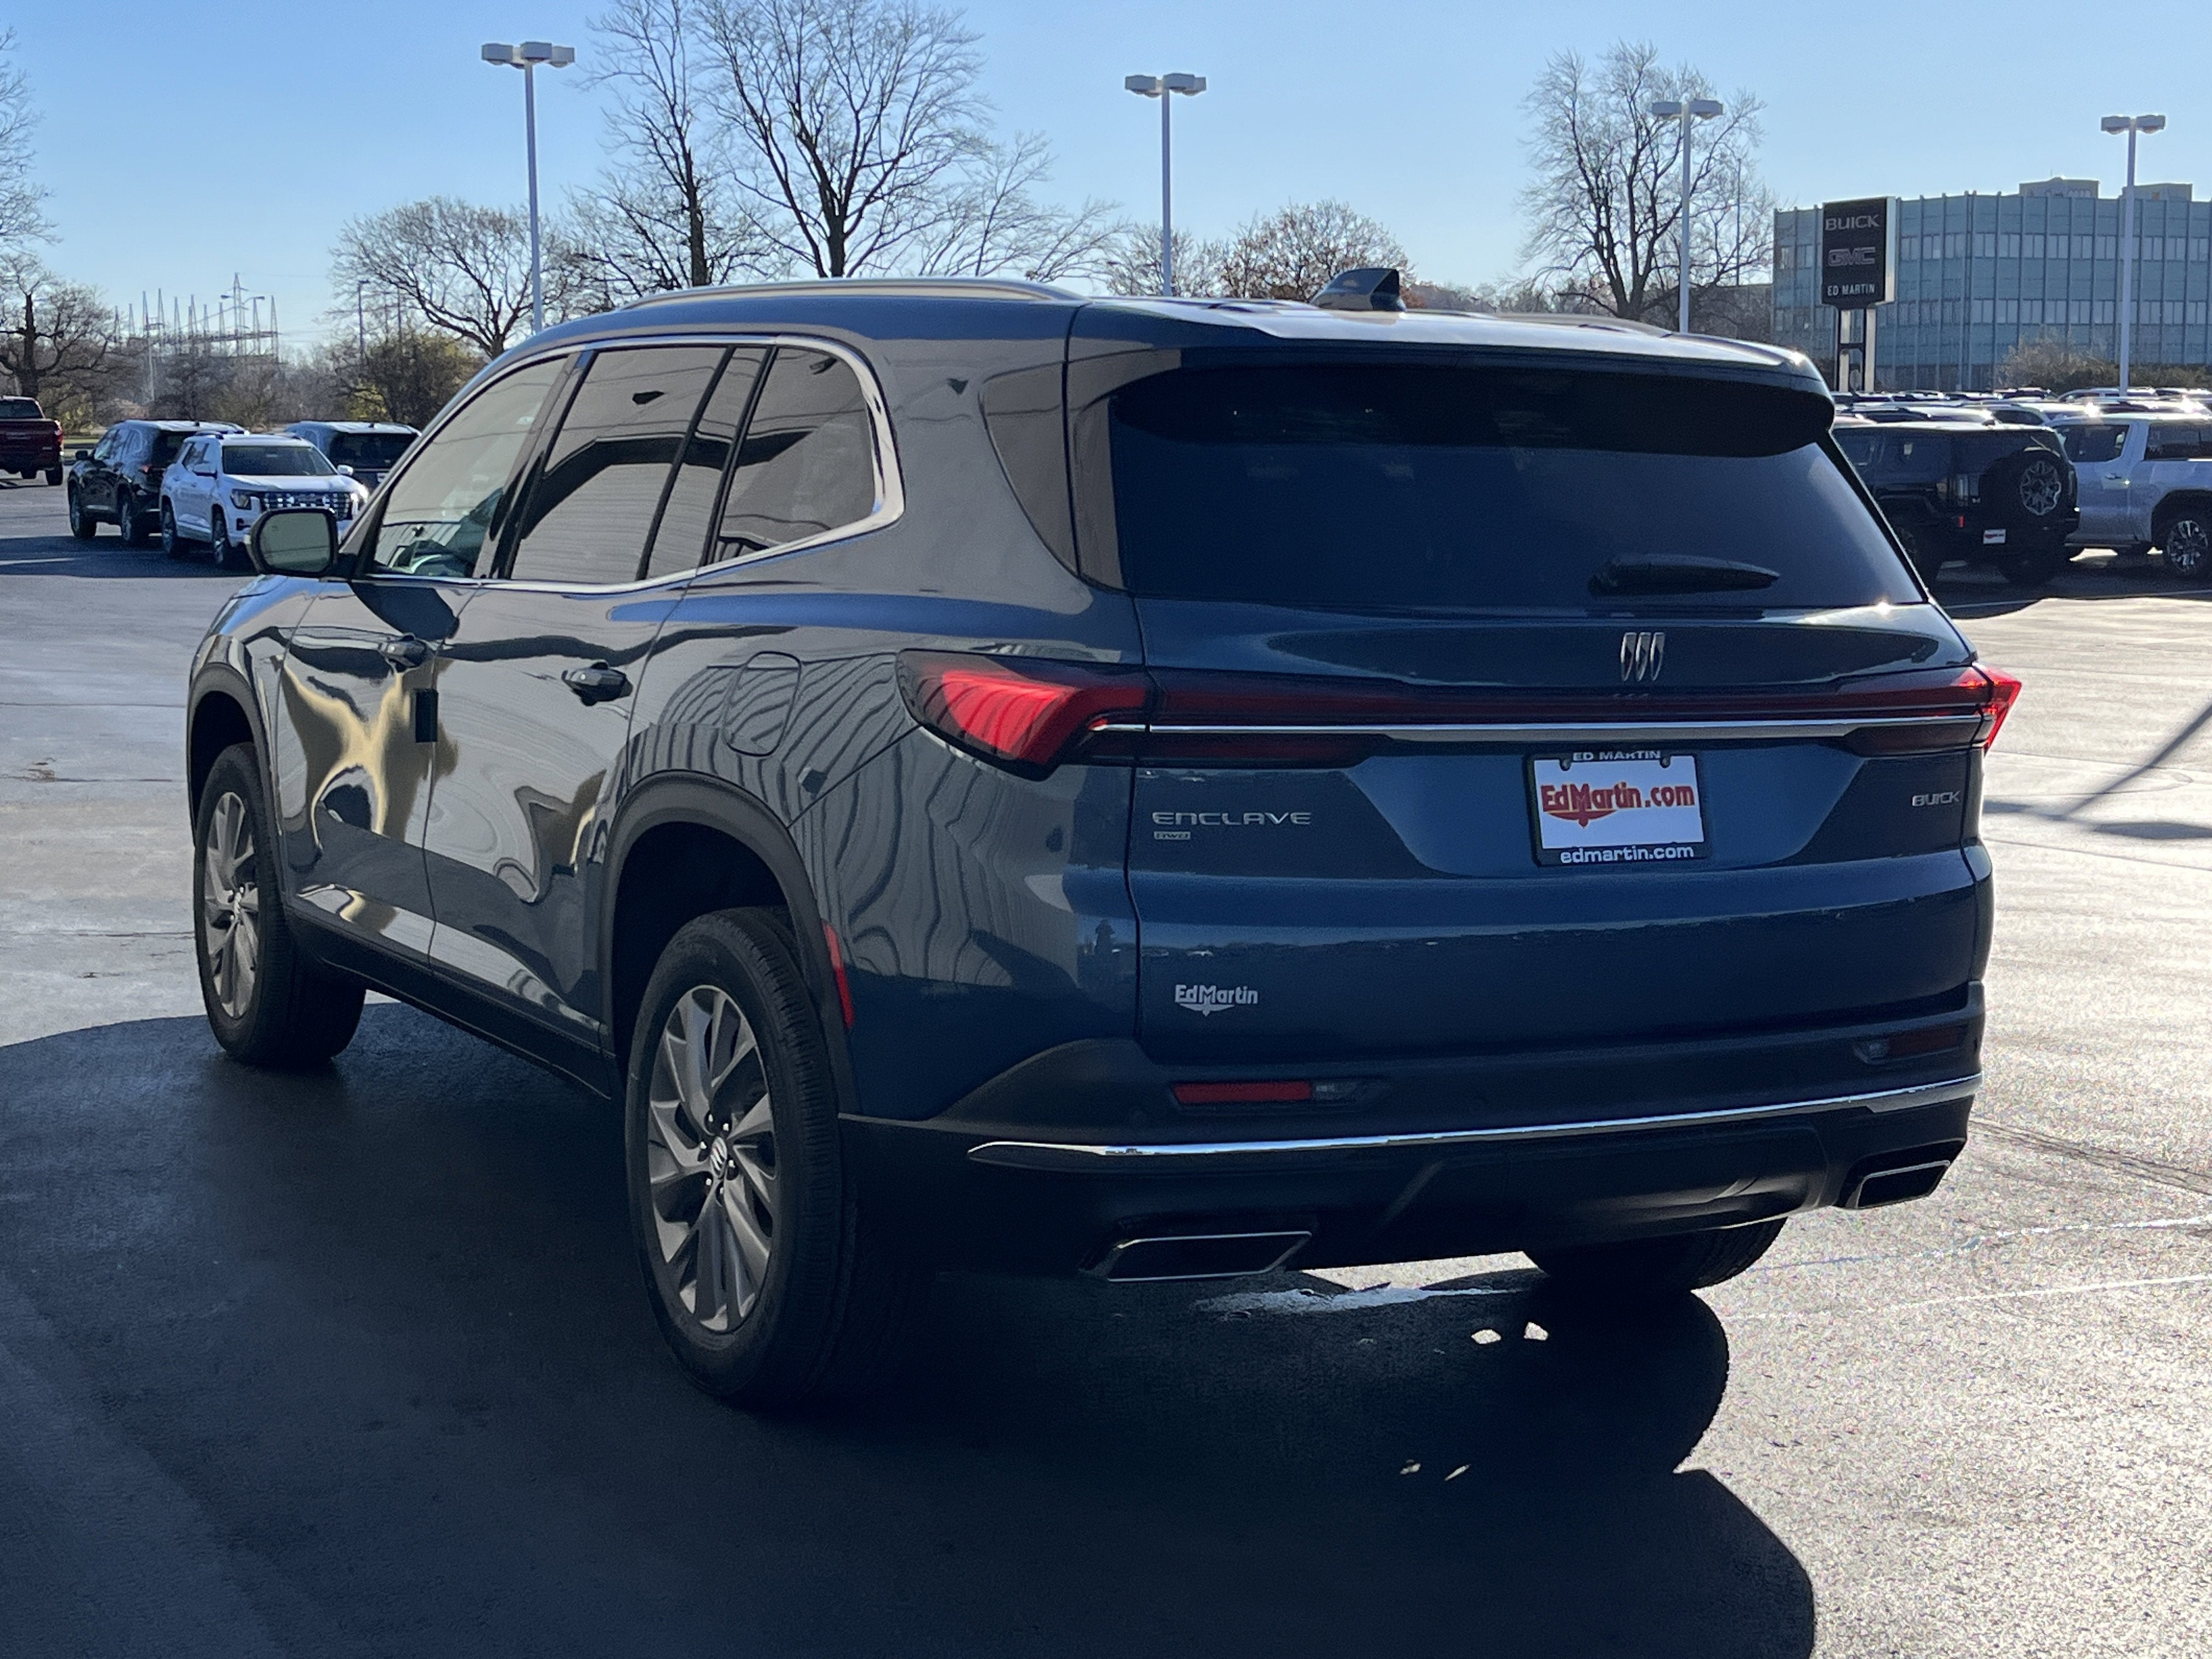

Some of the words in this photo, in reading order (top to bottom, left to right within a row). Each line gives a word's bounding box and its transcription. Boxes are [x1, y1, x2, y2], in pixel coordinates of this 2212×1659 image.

[1825, 214, 1879, 230] BUICK
[1828, 247, 1876, 267] GMC
[1827, 285, 1839, 296] ED
[1842, 284, 1875, 295] MARTIN
[1573, 752, 1594, 761] ED
[1599, 751, 1661, 760] MARTIN
[1912, 791, 1960, 806] BUICK
[1153, 812, 1311, 825] ENCLAVE
[1560, 845, 1694, 864] edmartin.com
